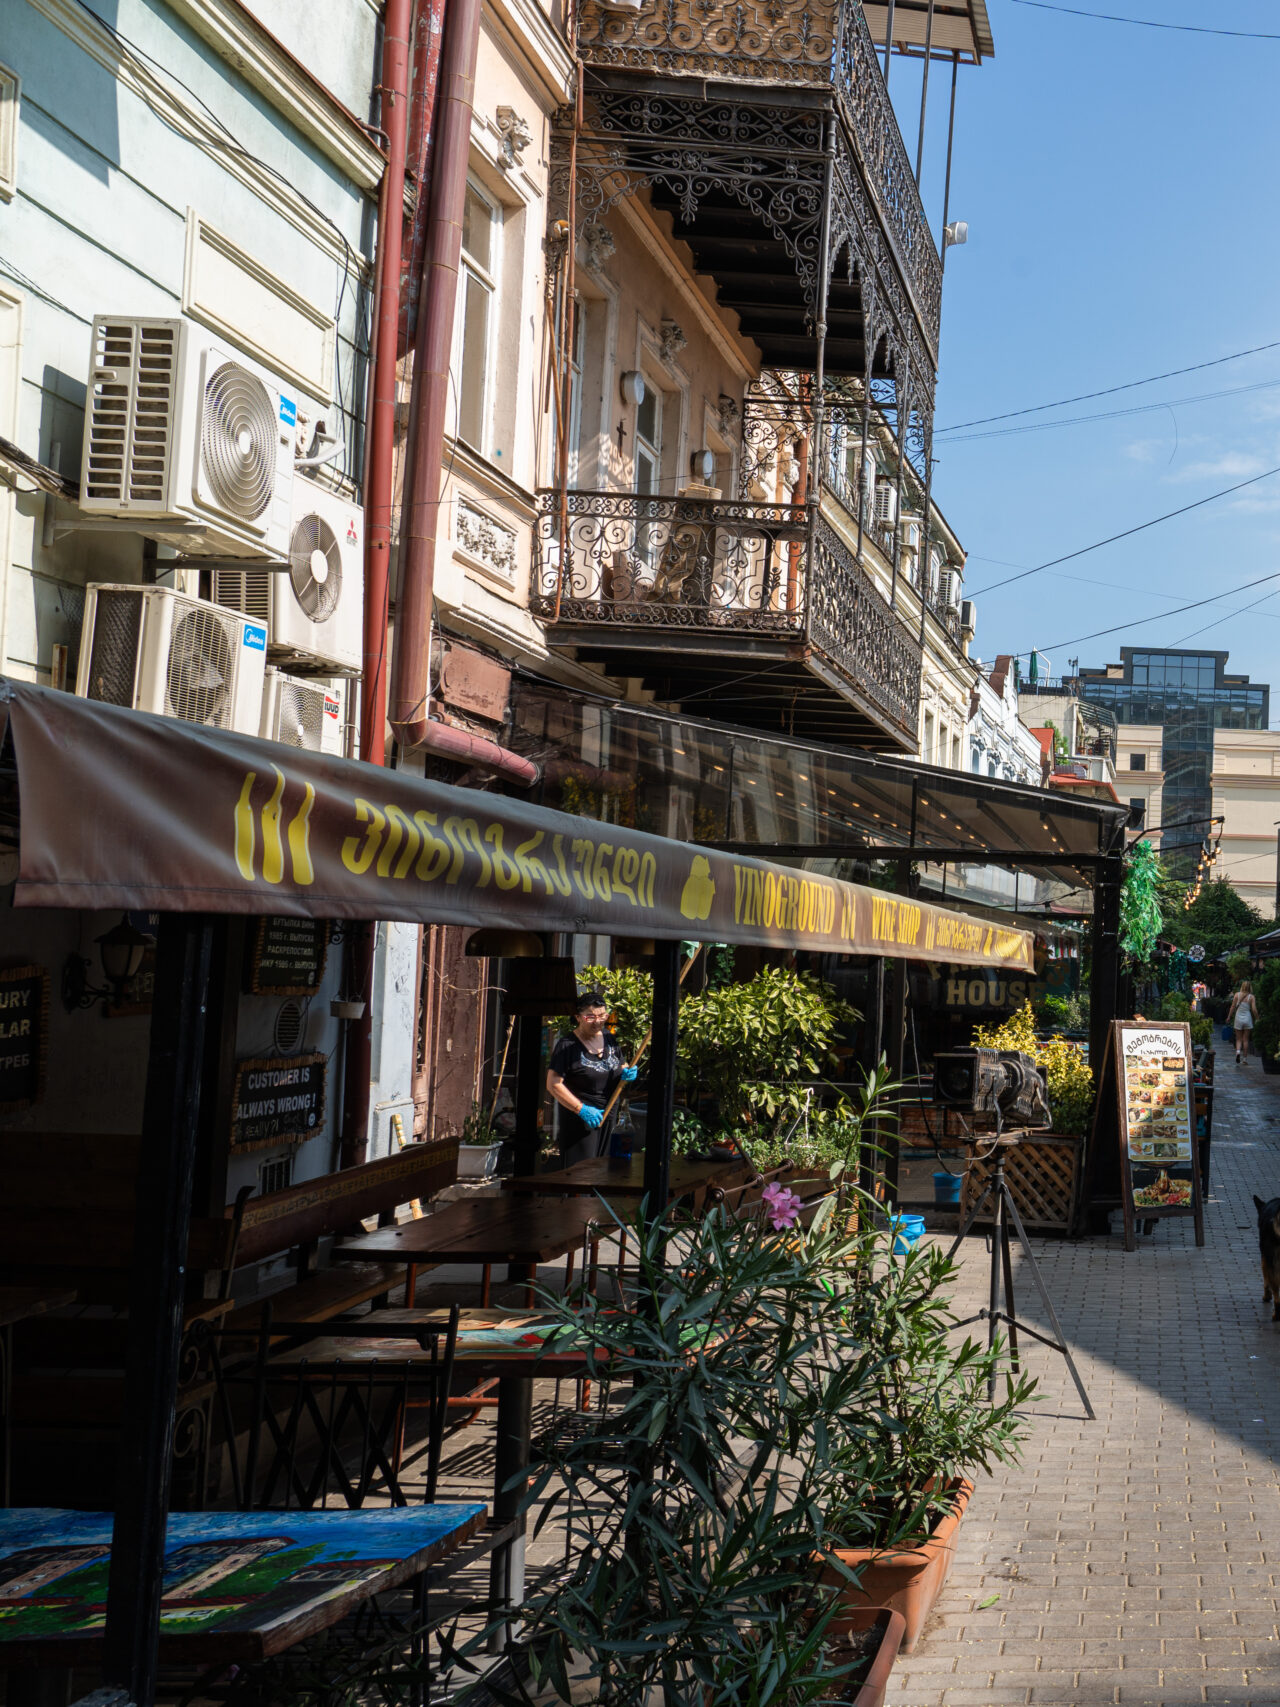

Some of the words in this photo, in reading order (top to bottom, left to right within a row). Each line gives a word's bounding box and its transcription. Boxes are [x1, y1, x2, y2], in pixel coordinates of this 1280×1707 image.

[341, 798, 657, 908] ვინოგრაუნდი
[733, 864, 836, 934] VINOGROUND
[872, 895, 896, 941] WINE
[897, 899, 921, 945] SHOP
[946, 979, 1046, 1007] HOUSE
[1126, 1034, 1182, 1055] მეგობრების
[248, 1070, 300, 1090] CUSTOMER
[301, 1067, 310, 1083] IS
[236, 1098, 275, 1119] ALWAYS
[277, 1095, 311, 1113] WRONG
